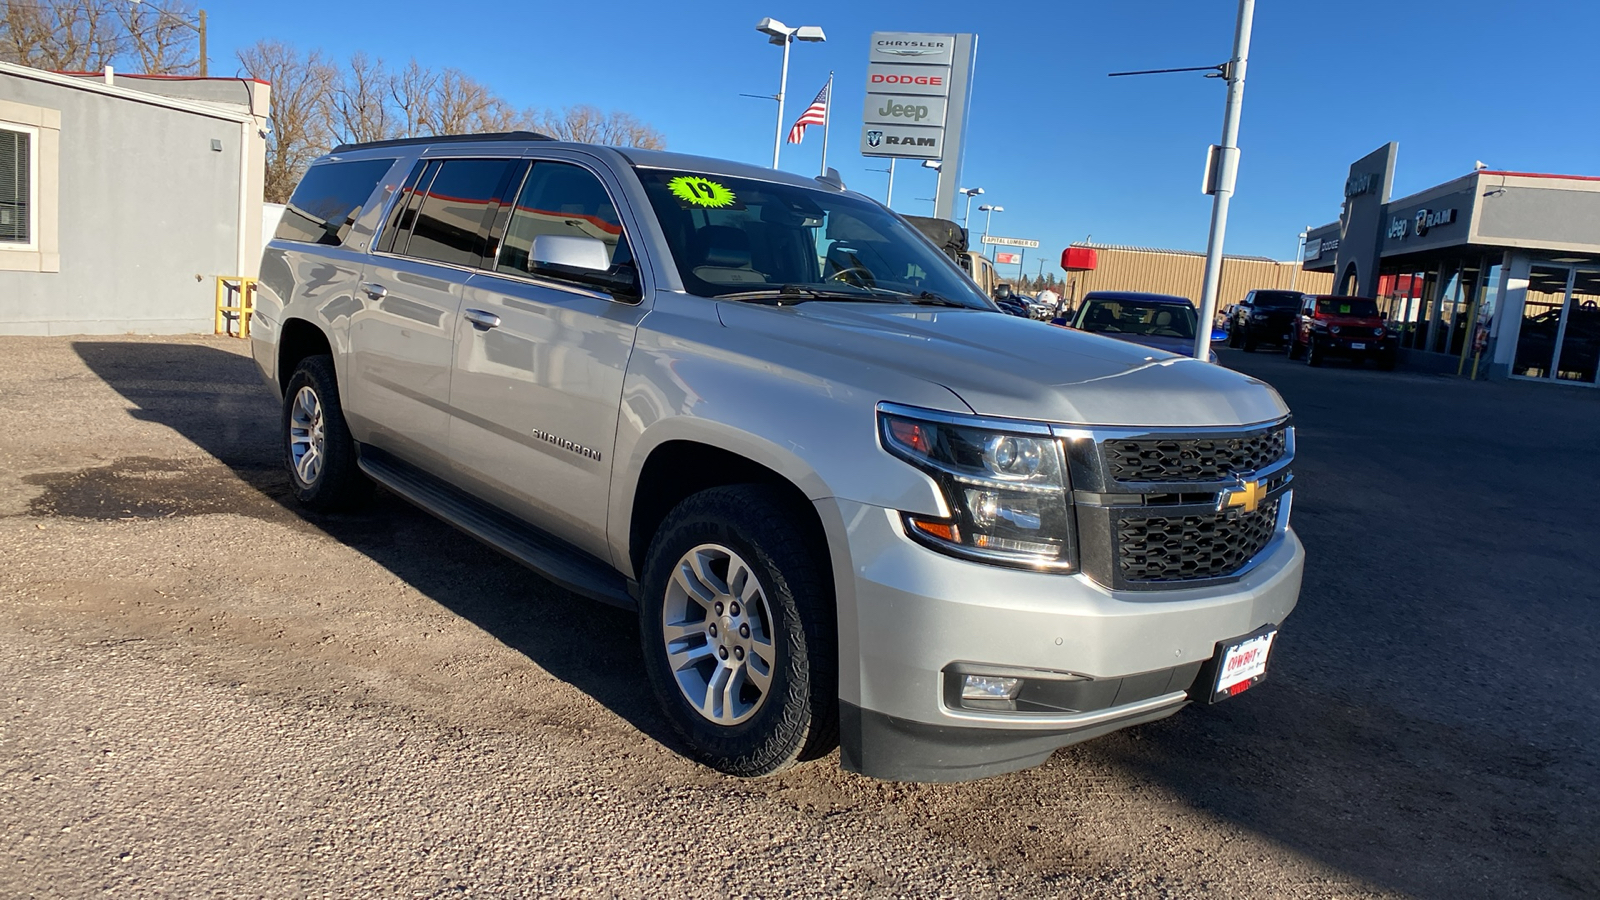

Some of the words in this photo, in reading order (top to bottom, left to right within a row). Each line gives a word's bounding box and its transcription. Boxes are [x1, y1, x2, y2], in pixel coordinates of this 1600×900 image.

[877, 40, 945, 48] CHRYSLER
[871, 74, 943, 86] DODGE
[878, 99, 929, 122] Jeep
[886, 135, 936, 148] RAM
[685, 181, 716, 200] 19
[1427, 209, 1452, 227] RAM
[1389, 216, 1408, 241] Jeep
[1007, 238, 1028, 246] LUMBER
[1321, 239, 1340, 252] DODGE
[532, 428, 602, 462] SUBURBAN
[1227, 648, 1259, 672] COWBOY
